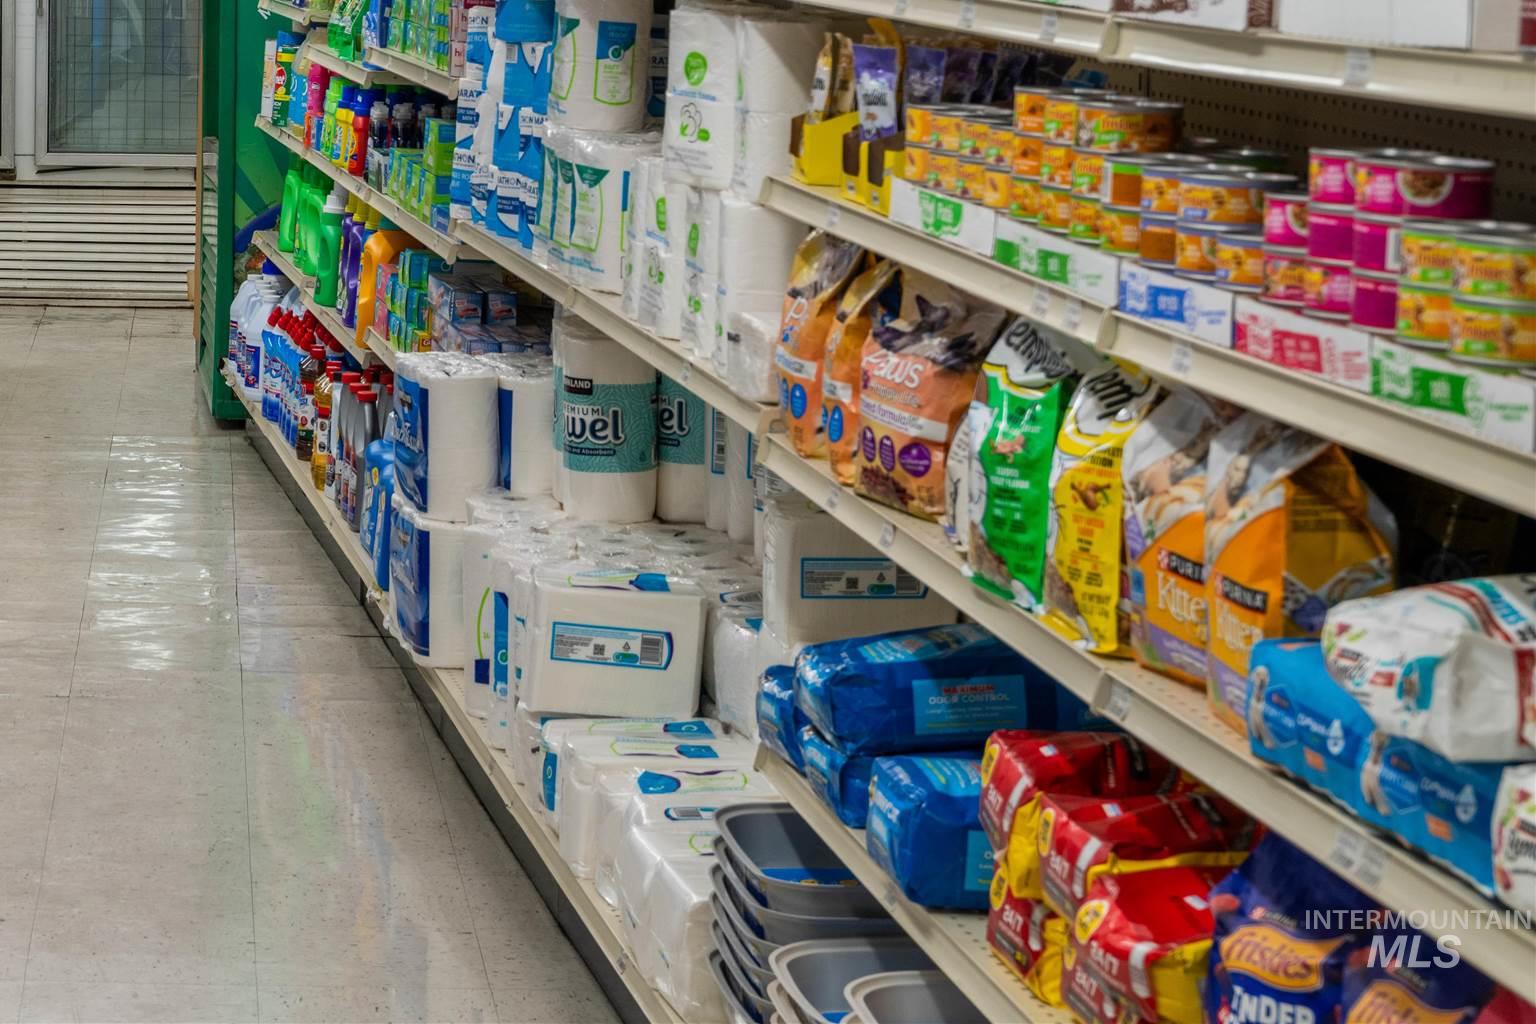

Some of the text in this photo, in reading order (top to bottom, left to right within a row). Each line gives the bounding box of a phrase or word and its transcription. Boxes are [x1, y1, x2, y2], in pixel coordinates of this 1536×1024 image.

[566, 405, 600, 416] EMIUM
[566, 408, 625, 442] wel
[1157, 571, 1206, 622] Kitte
[961, 693, 1011, 703] CONTROL
